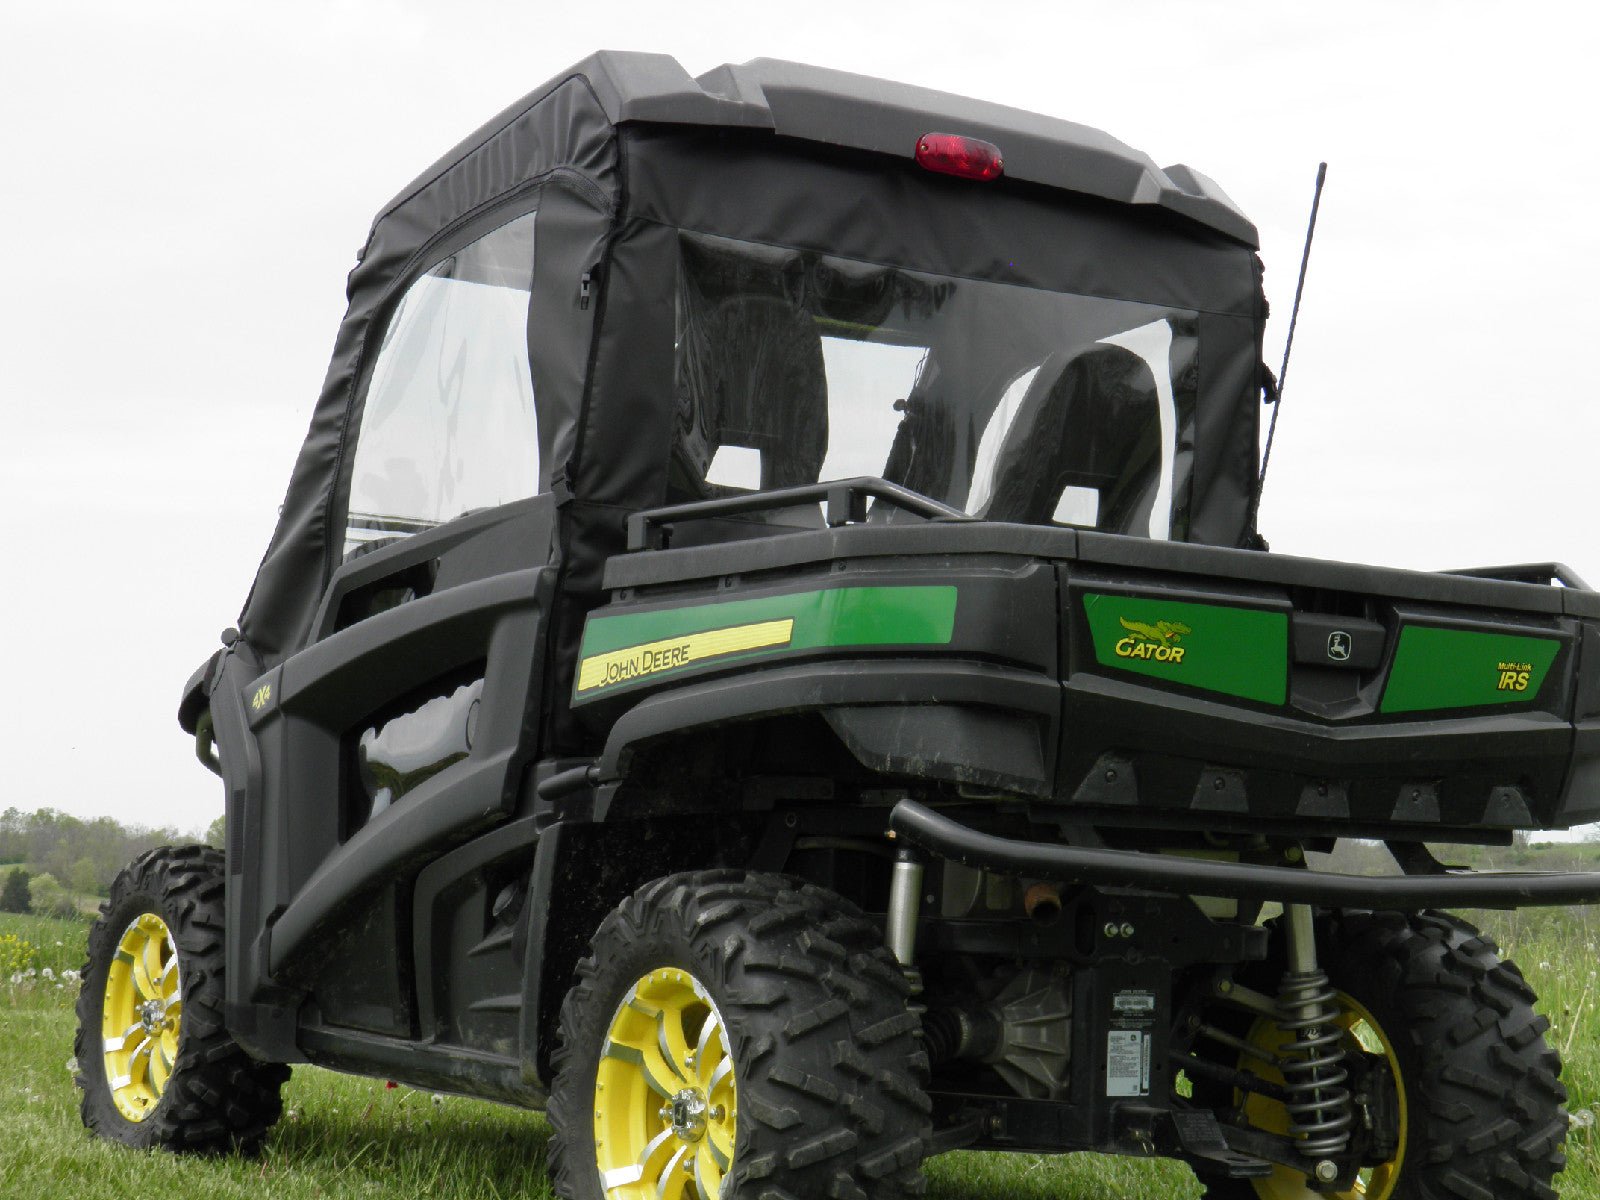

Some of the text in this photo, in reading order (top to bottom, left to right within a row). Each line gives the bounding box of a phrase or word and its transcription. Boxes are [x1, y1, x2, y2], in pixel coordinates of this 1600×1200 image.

[600, 644, 691, 684] JOHN DEERE
[1115, 637, 1185, 664] GATOR
[1497, 671, 1530, 691] IRS
